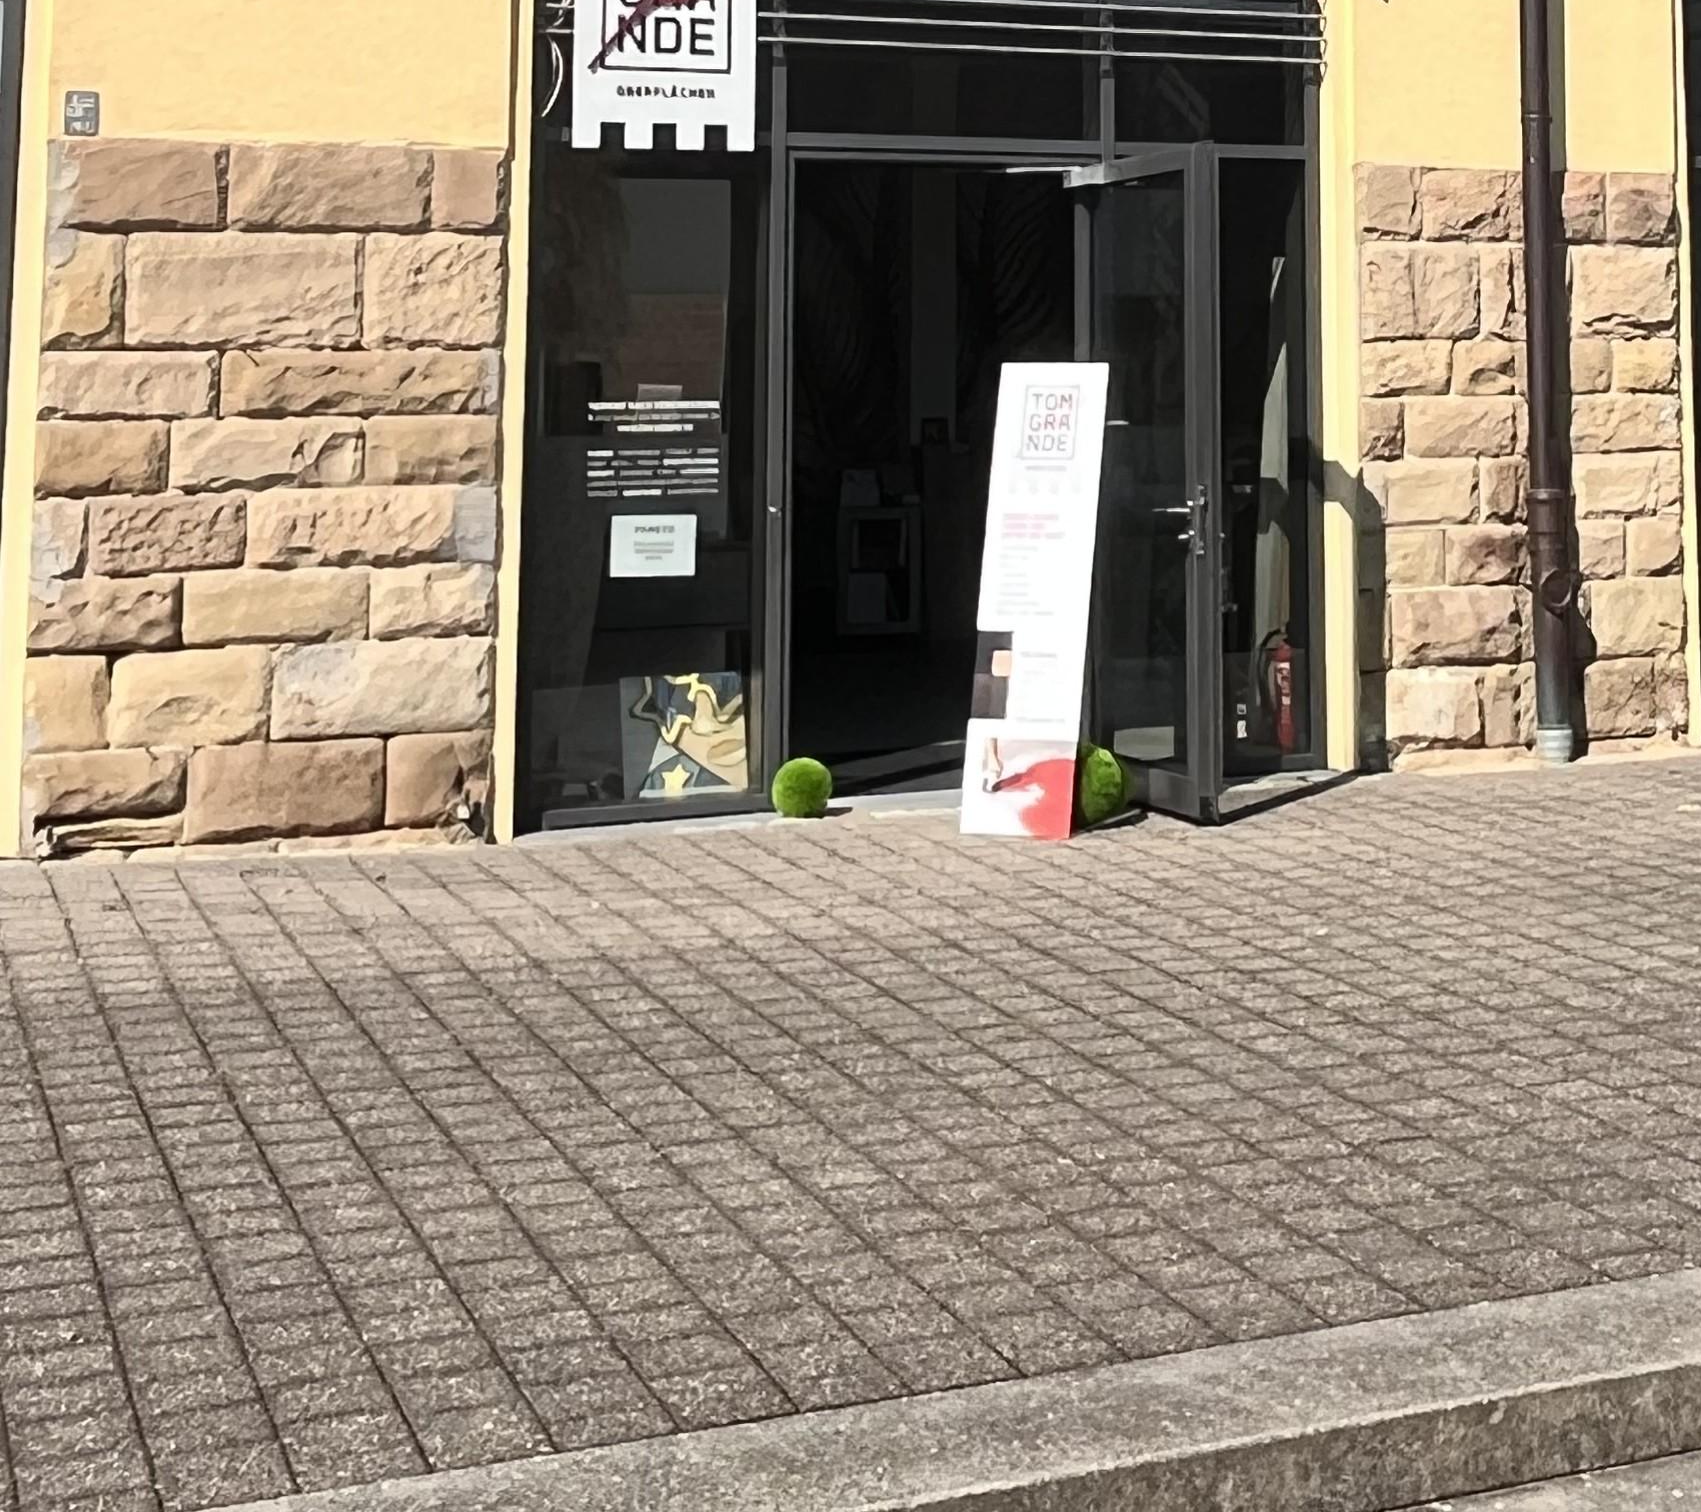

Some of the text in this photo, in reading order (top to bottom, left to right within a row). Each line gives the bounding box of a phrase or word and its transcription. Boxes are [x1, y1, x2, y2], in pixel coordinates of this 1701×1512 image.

[617, 14, 715, 56] NDE
[1031, 392, 1073, 411] TOM
[1029, 413, 1071, 432] GRA
[1026, 433, 1068, 452] NDE
